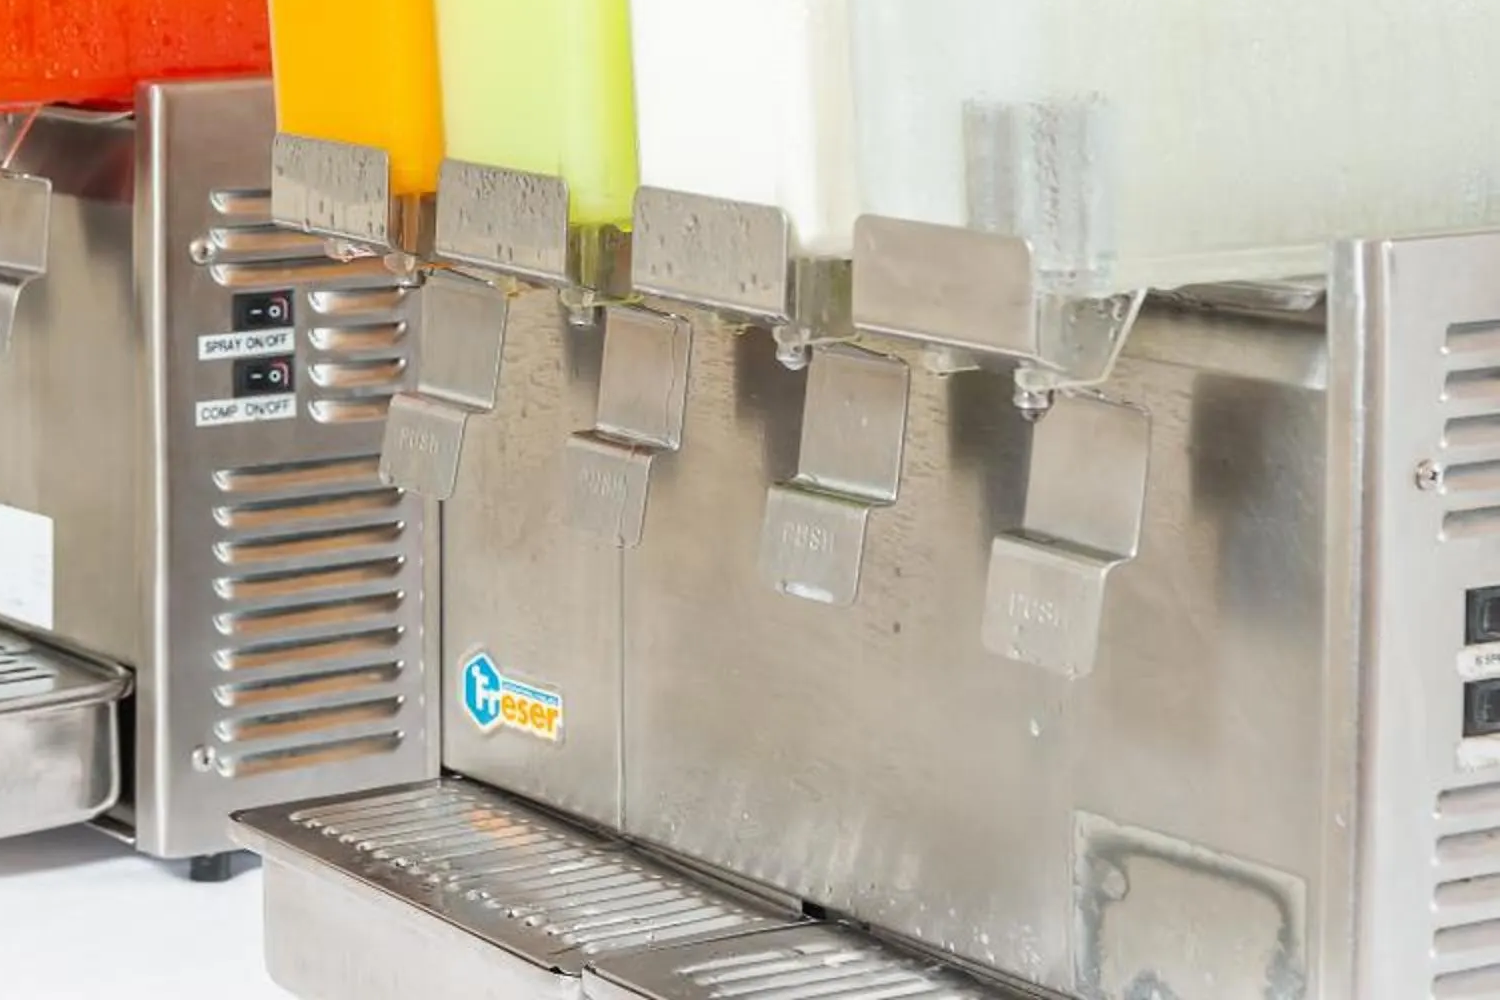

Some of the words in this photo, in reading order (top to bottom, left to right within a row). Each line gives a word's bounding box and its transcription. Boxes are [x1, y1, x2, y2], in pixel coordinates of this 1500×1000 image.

[205, 338, 242, 354] SPRAY
[245, 333, 288, 349] ON/OFF
[201, 405, 239, 420] COMP
